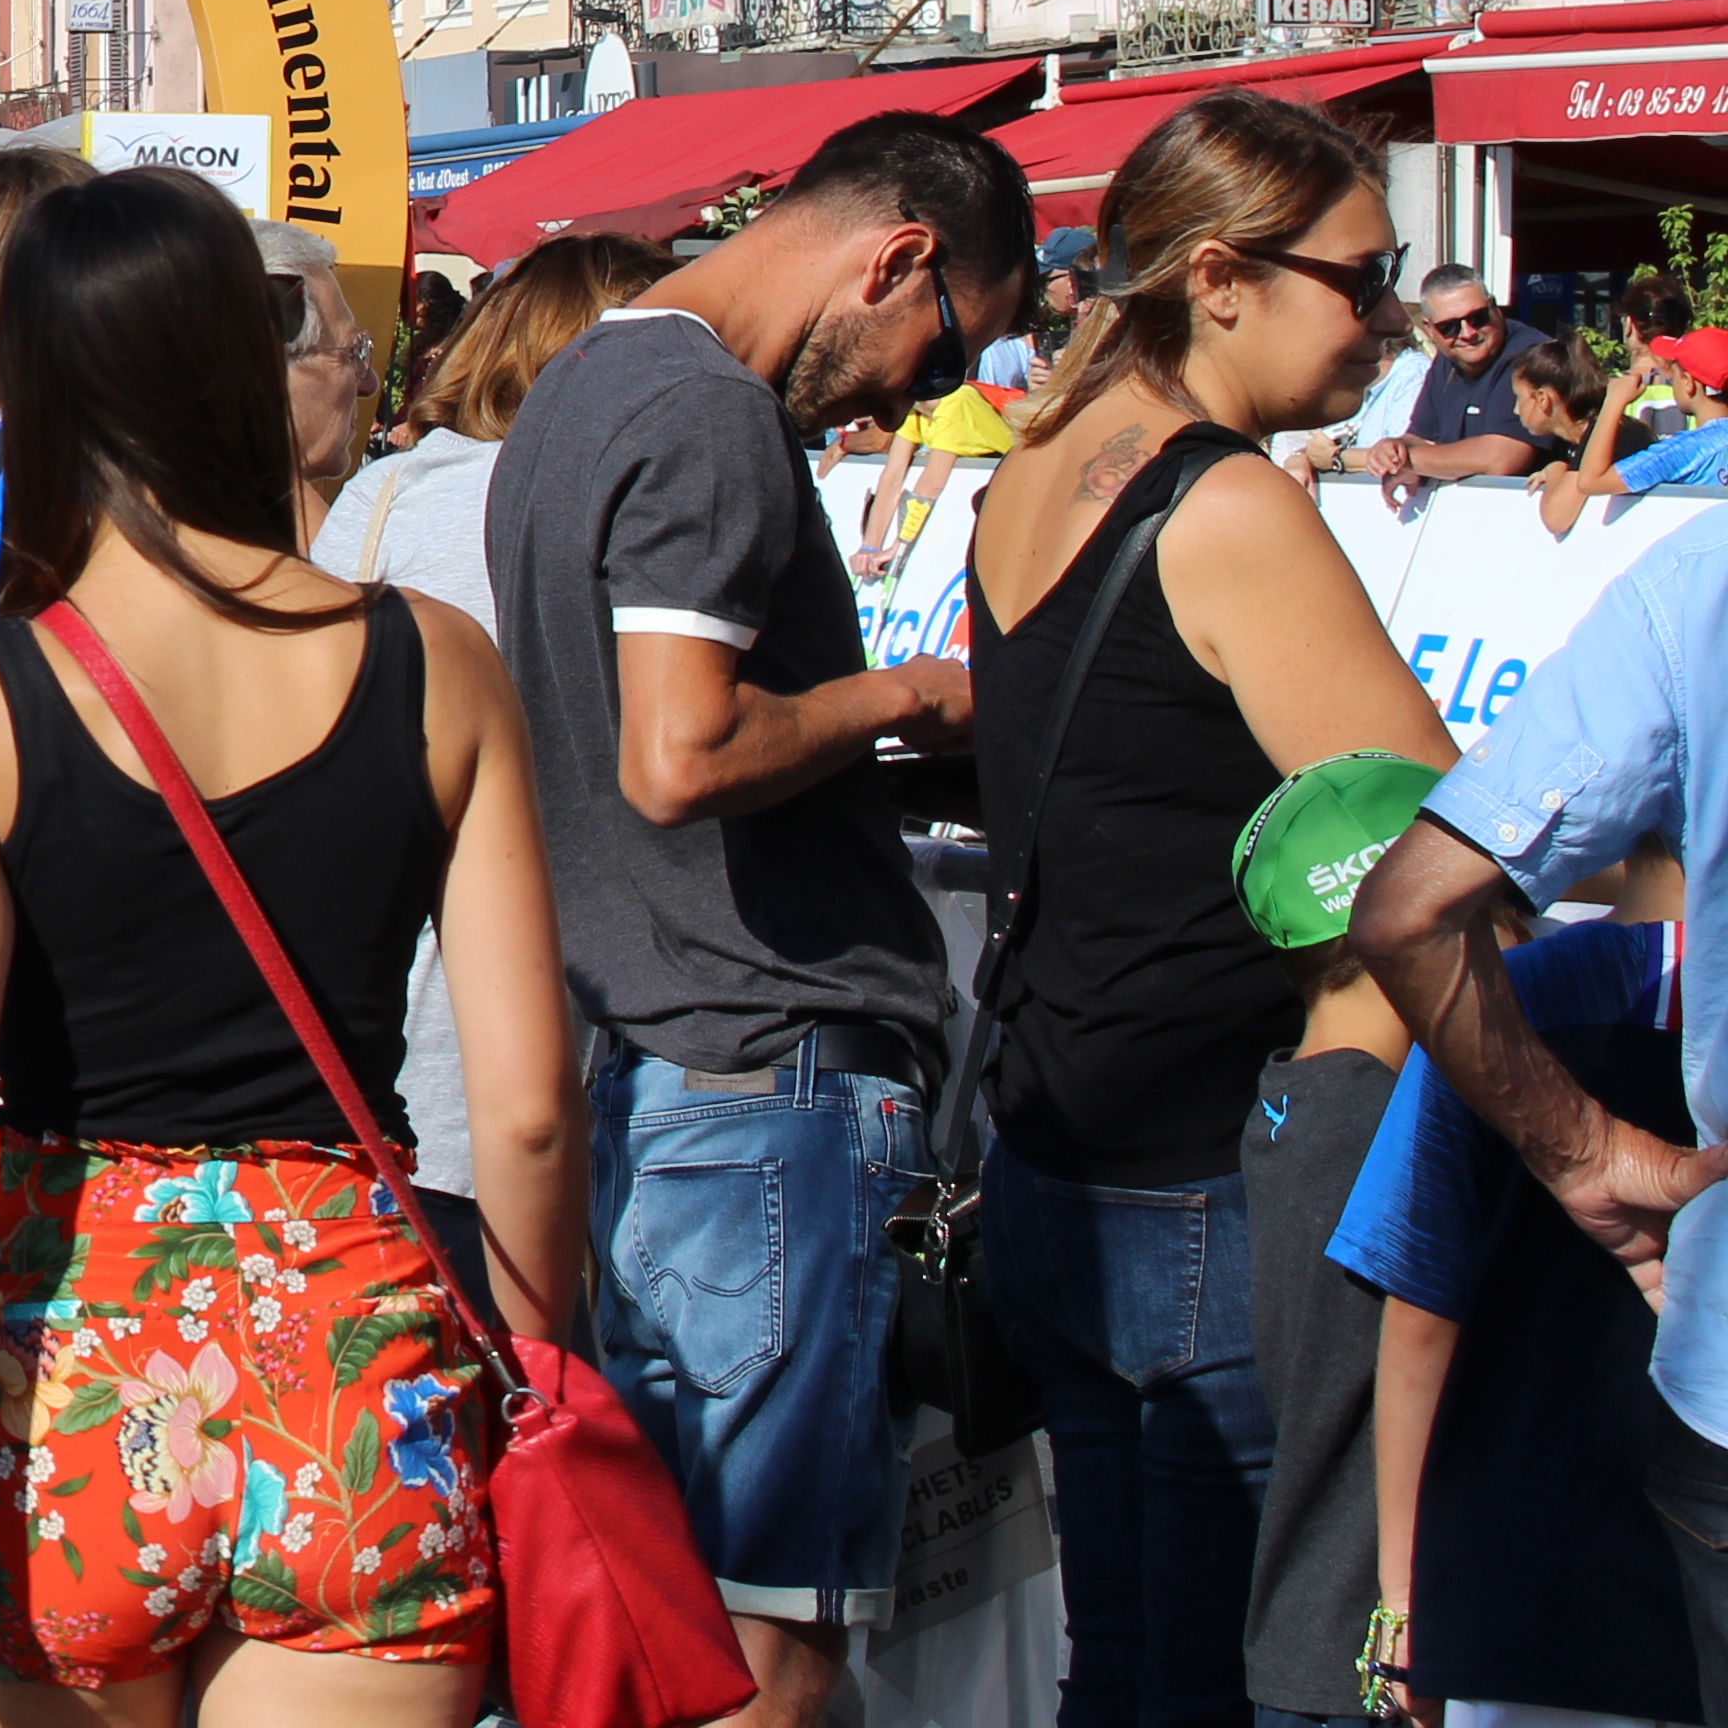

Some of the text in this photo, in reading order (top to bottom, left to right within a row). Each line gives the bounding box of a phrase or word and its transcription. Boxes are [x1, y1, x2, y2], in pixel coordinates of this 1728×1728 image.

[71, 1, 110, 22] 1664
[1565, 79, 1606, 121] Tel
[1616, 87, 1645, 118] 03
[1645, 86, 1678, 116] 85
[1673, 84, 1707, 115] 39
[416, 170, 435, 191] Vent
[436, 168, 471, 190] d'Ouest
[1306, 833, 1402, 896] ŠKO
